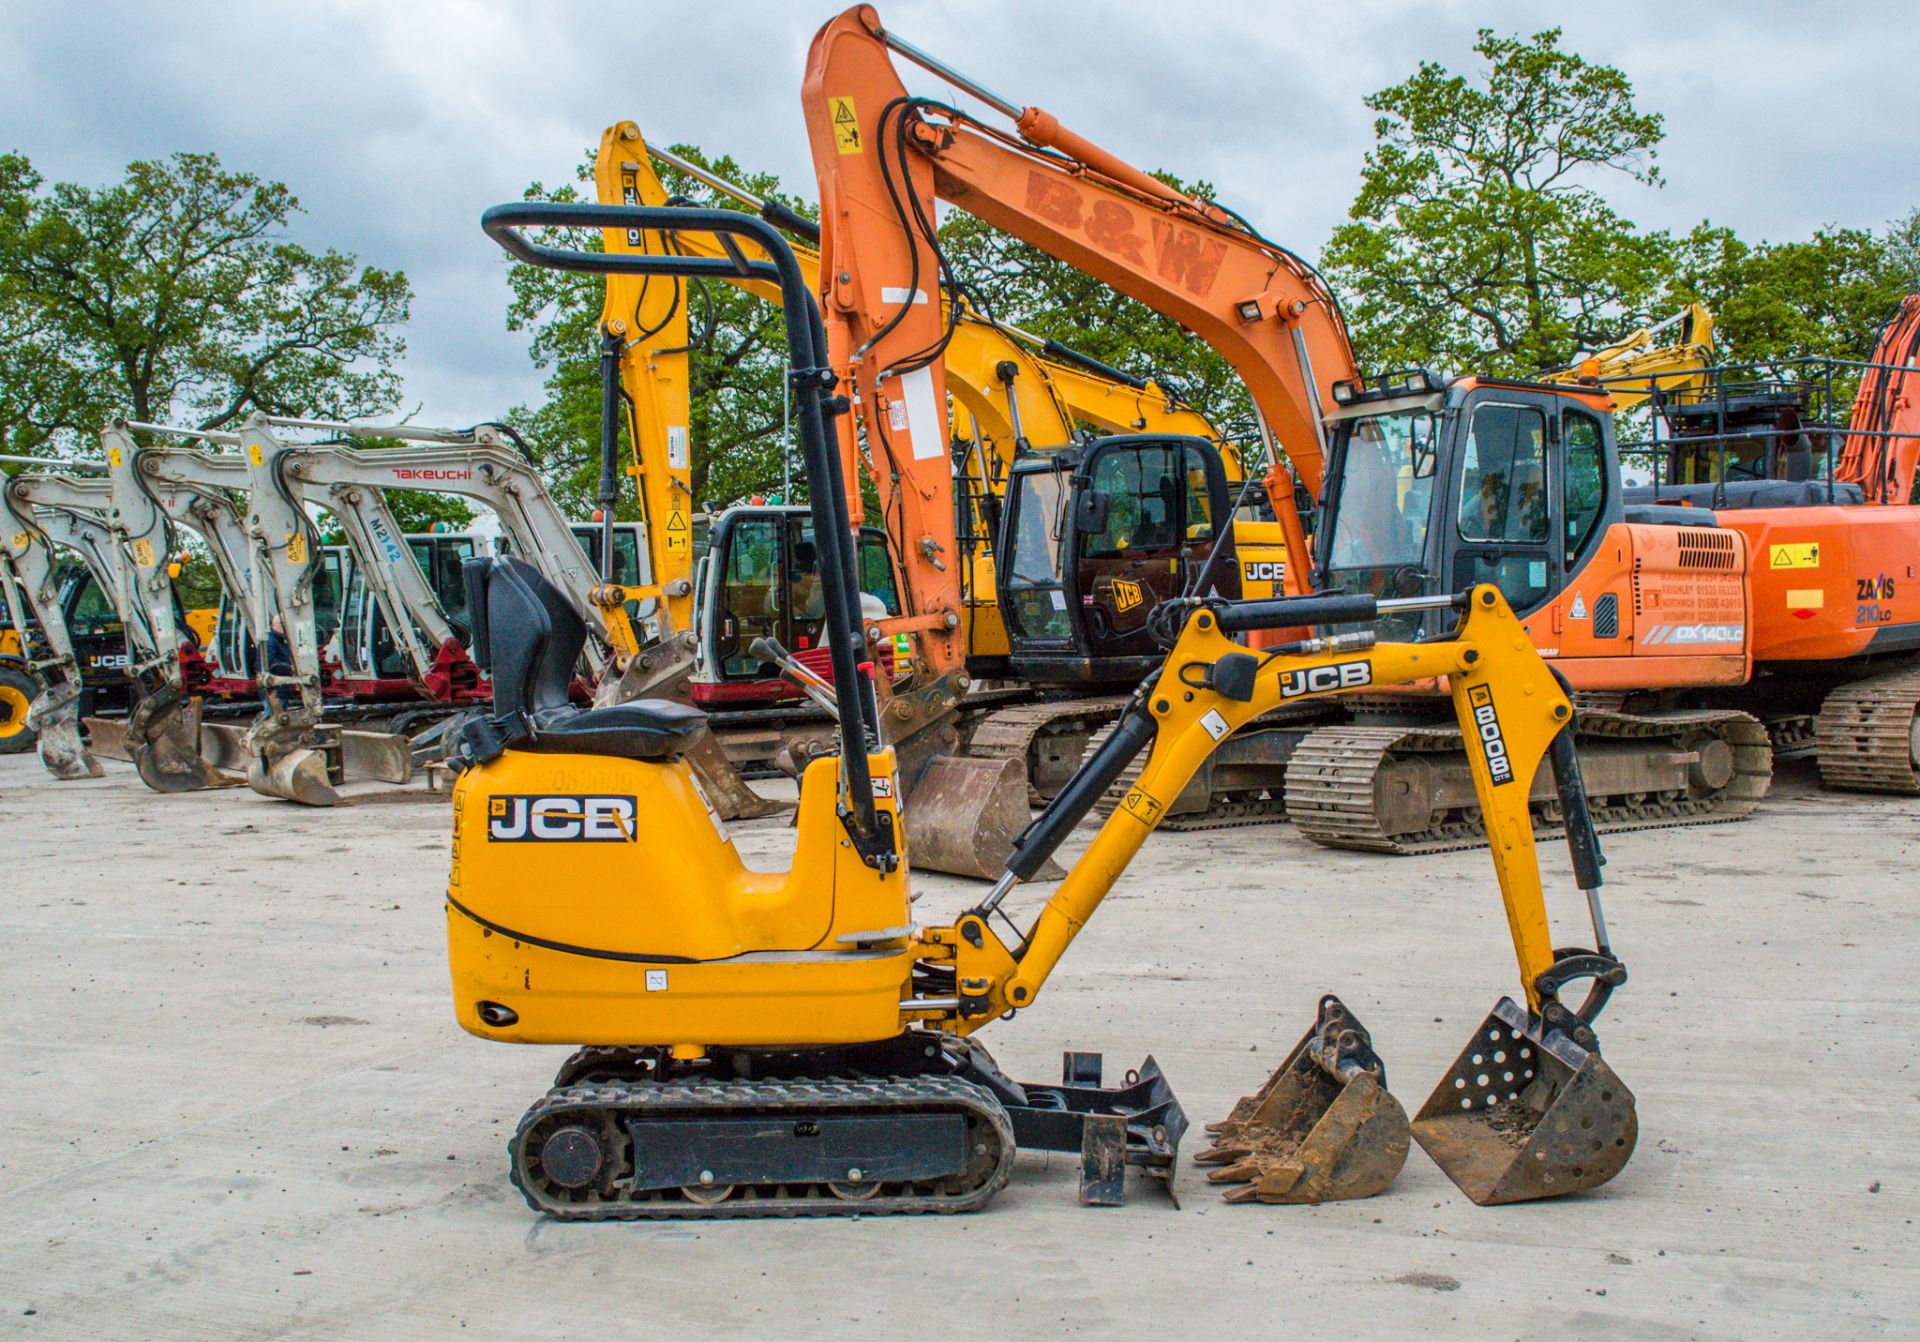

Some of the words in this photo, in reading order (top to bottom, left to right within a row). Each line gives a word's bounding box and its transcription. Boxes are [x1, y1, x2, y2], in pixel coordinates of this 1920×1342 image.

[392, 469, 472, 480] TAKEUCHI
[1117, 582, 1141, 610] JCB
[1857, 573, 1894, 600] ZAXIS
[91, 655, 127, 667] JCB
[1281, 662, 1371, 697] JCB
[1475, 705, 1510, 775] 8008
[491, 798, 634, 839] JCB
